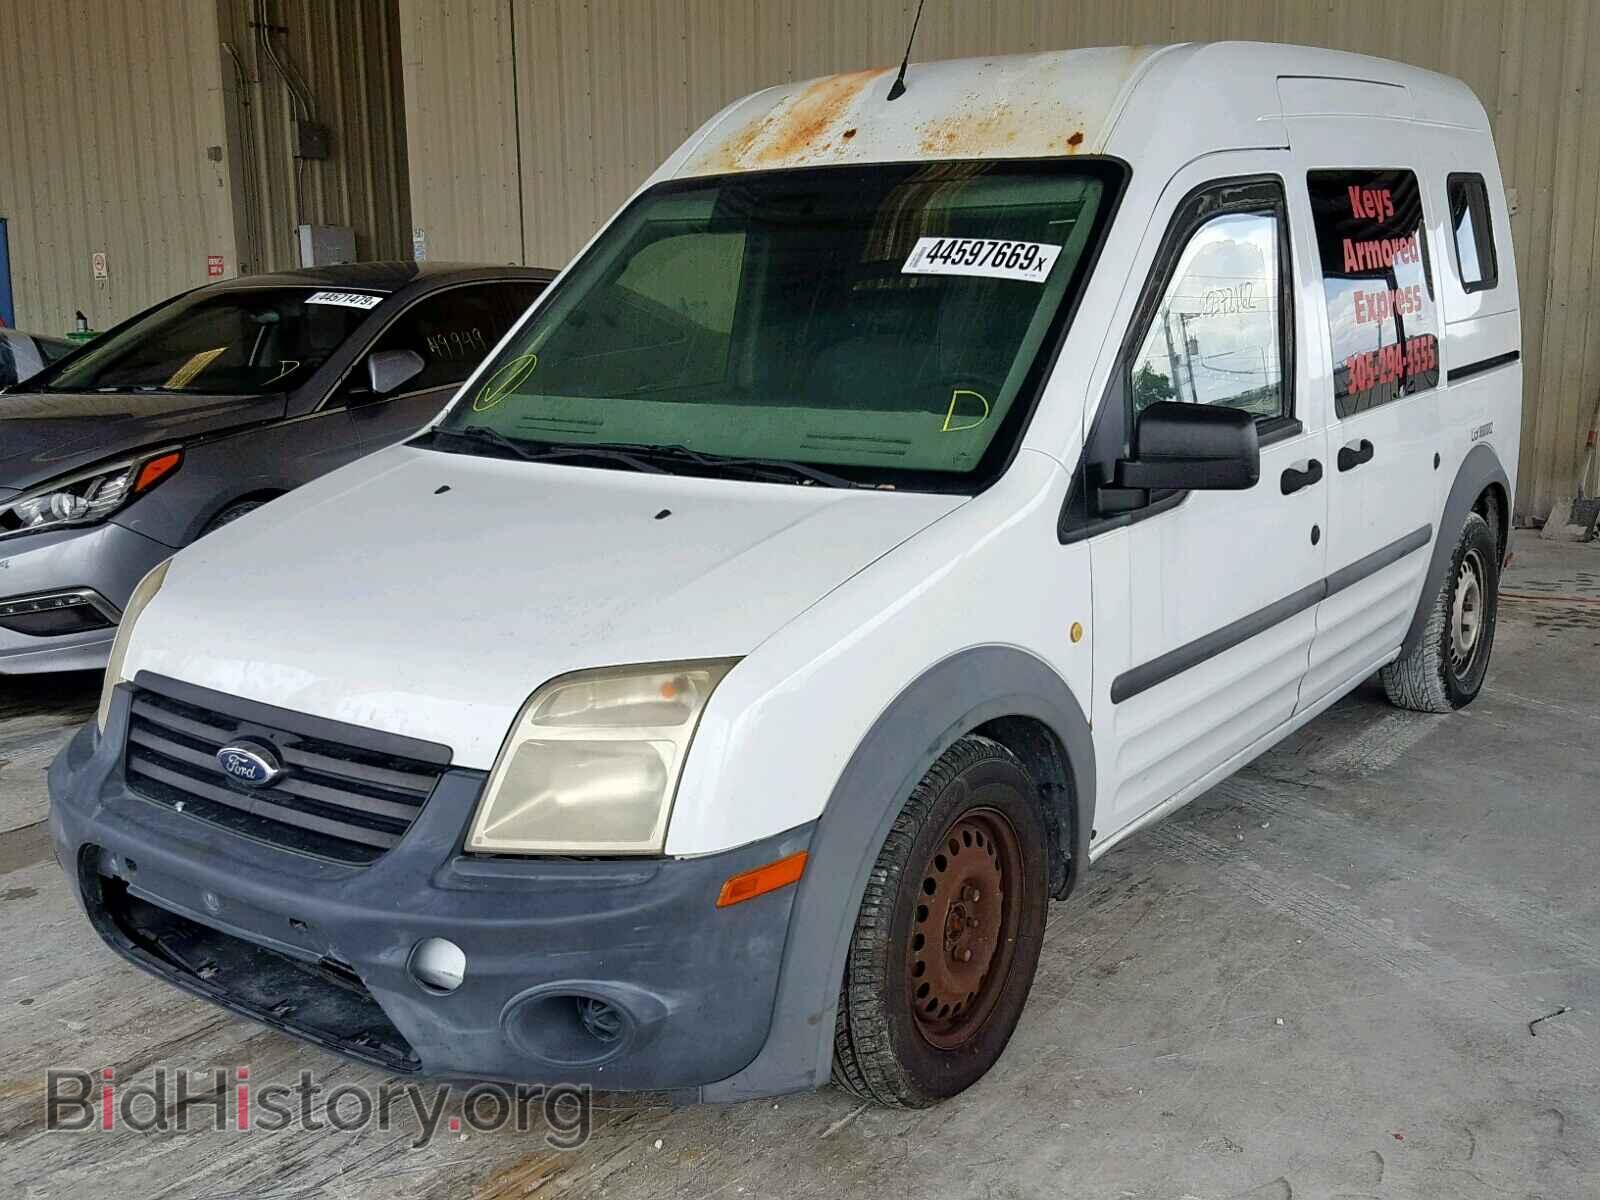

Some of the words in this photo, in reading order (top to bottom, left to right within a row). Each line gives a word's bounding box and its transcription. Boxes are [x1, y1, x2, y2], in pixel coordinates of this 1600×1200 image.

[1347, 185, 1394, 223] Keys
[1343, 231, 1419, 273] Armored
[1353, 285, 1423, 325] Express
[941, 389, 989, 432] D
[226, 754, 256, 779] Ford
